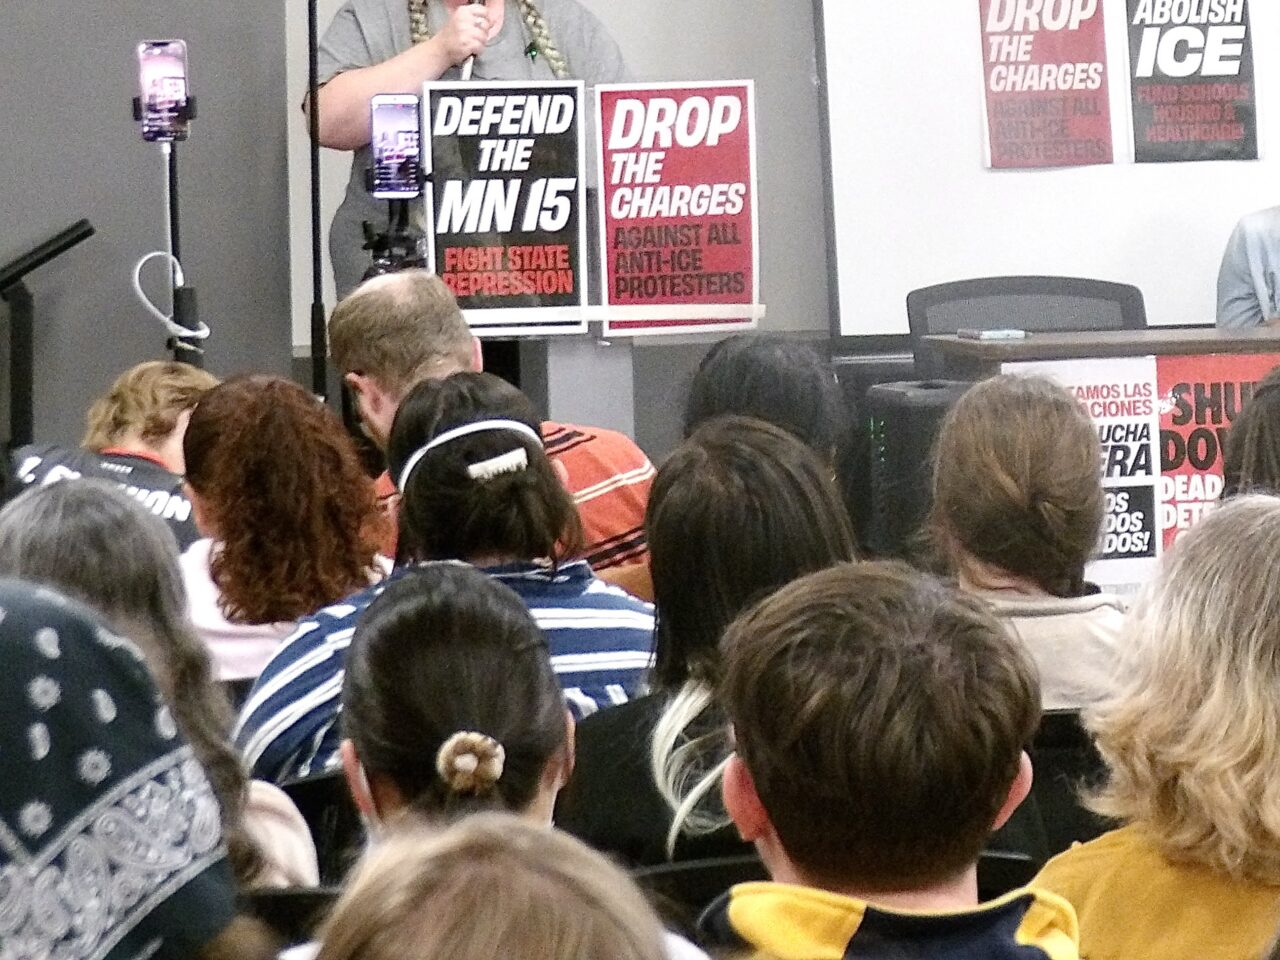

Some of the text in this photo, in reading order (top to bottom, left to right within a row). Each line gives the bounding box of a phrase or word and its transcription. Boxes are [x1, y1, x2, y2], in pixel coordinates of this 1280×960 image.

[989, 34, 1034, 62] THE
[1135, 25, 1246, 77] ICE
[990, 62, 1103, 92] CHARGES
[433, 94, 575, 136] DEFEND
[608, 95, 742, 149] DROP
[478, 138, 535, 171] THE
[610, 151, 665, 184] THE
[437, 177, 577, 234] MN 15
[610, 183, 745, 219] CHARGES
[613, 222, 742, 249] AGAINST ALL
[444, 244, 570, 271] FIGHT STATE
[614, 249, 702, 274] ANTI-ICE
[443, 270, 574, 297] REPRESSION
[615, 271, 745, 299] PROTESTERS
[1066, 382, 1152, 401] AMOS LAS
[1172, 381, 1260, 426] SHU
[1099, 423, 1151, 443] UCHA
[1161, 474, 1225, 502] DEAD
[1102, 531, 1151, 553] DOS!
